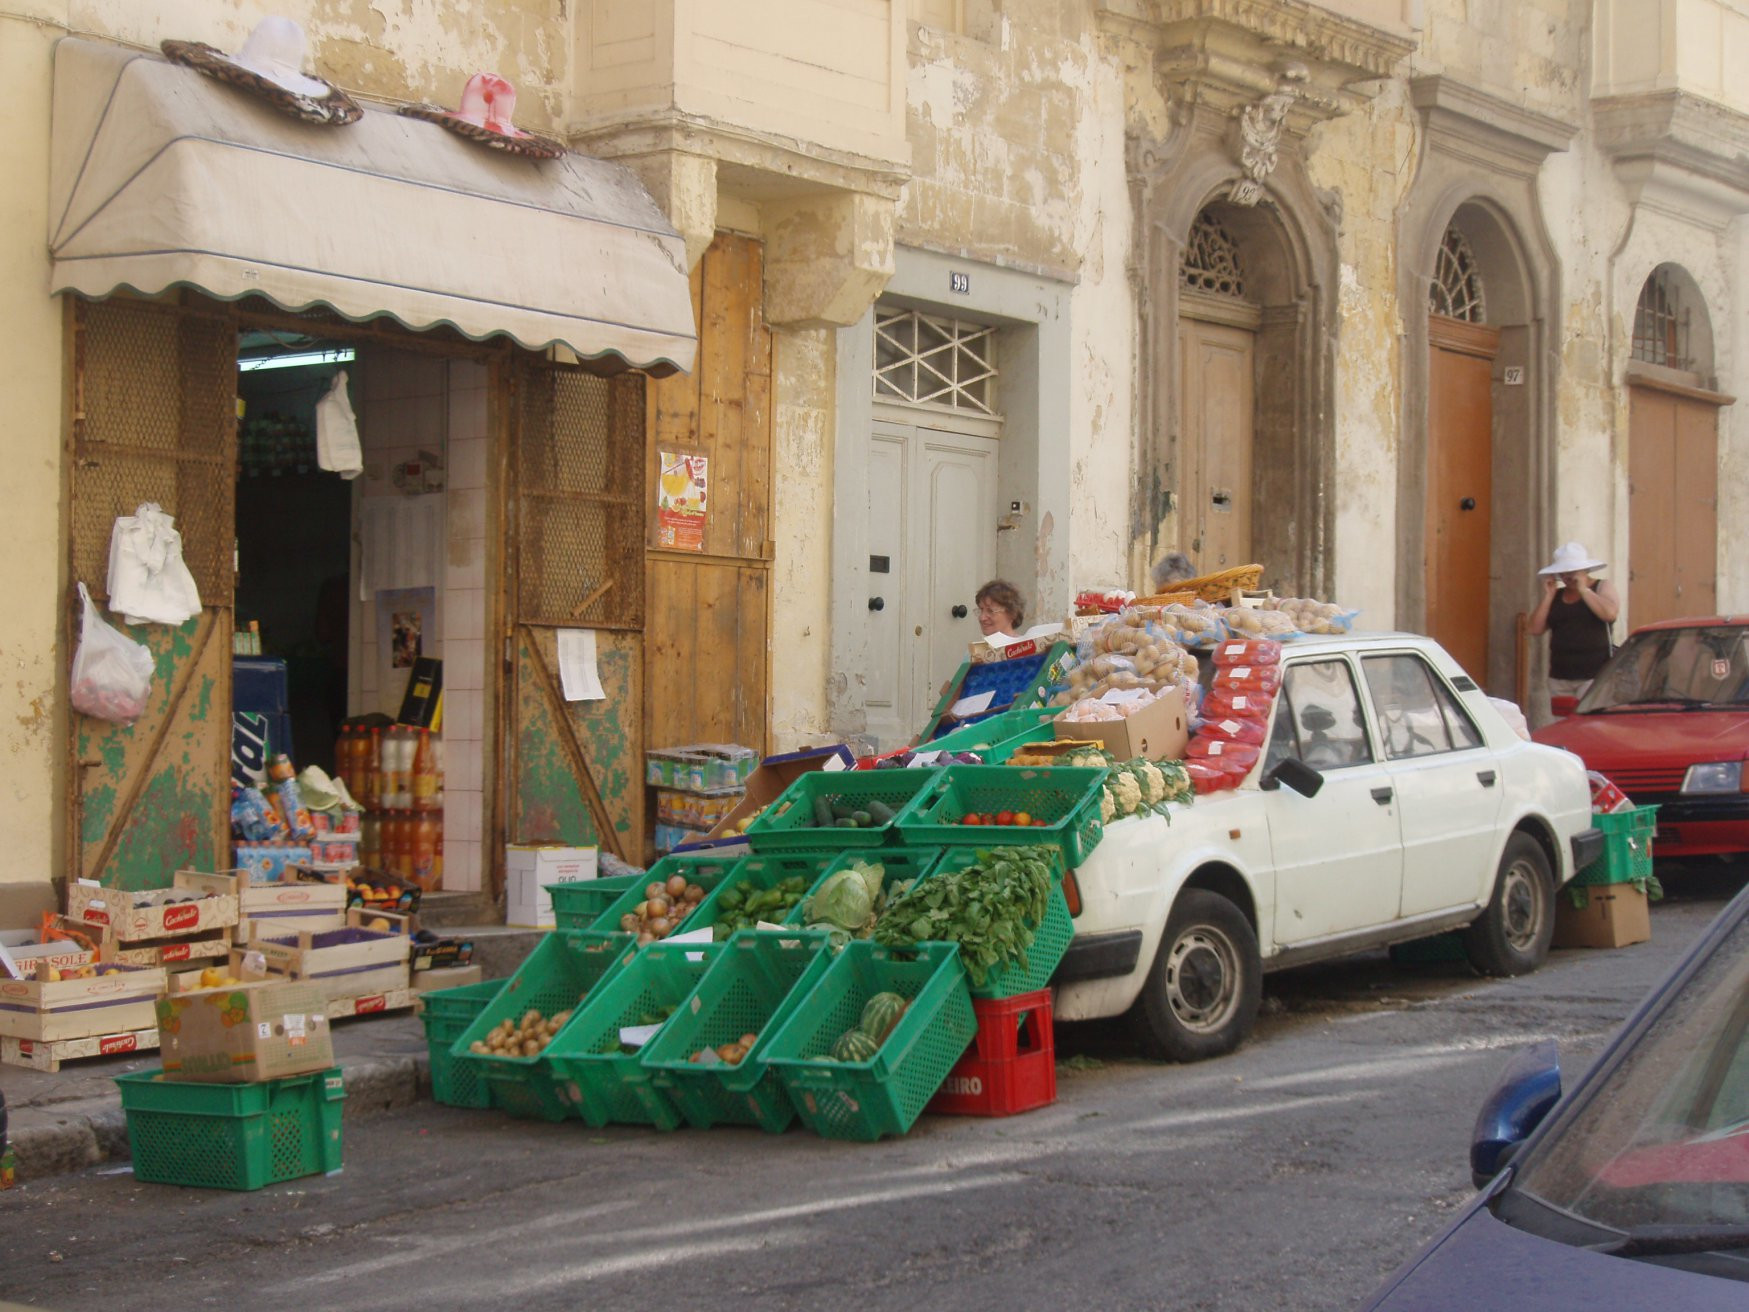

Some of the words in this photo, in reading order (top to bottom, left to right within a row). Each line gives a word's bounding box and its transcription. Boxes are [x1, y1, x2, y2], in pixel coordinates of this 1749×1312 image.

[954, 274, 967, 291] 99
[1507, 369, 1520, 382] 97
[15, 953, 88, 970] GIRSOLE
